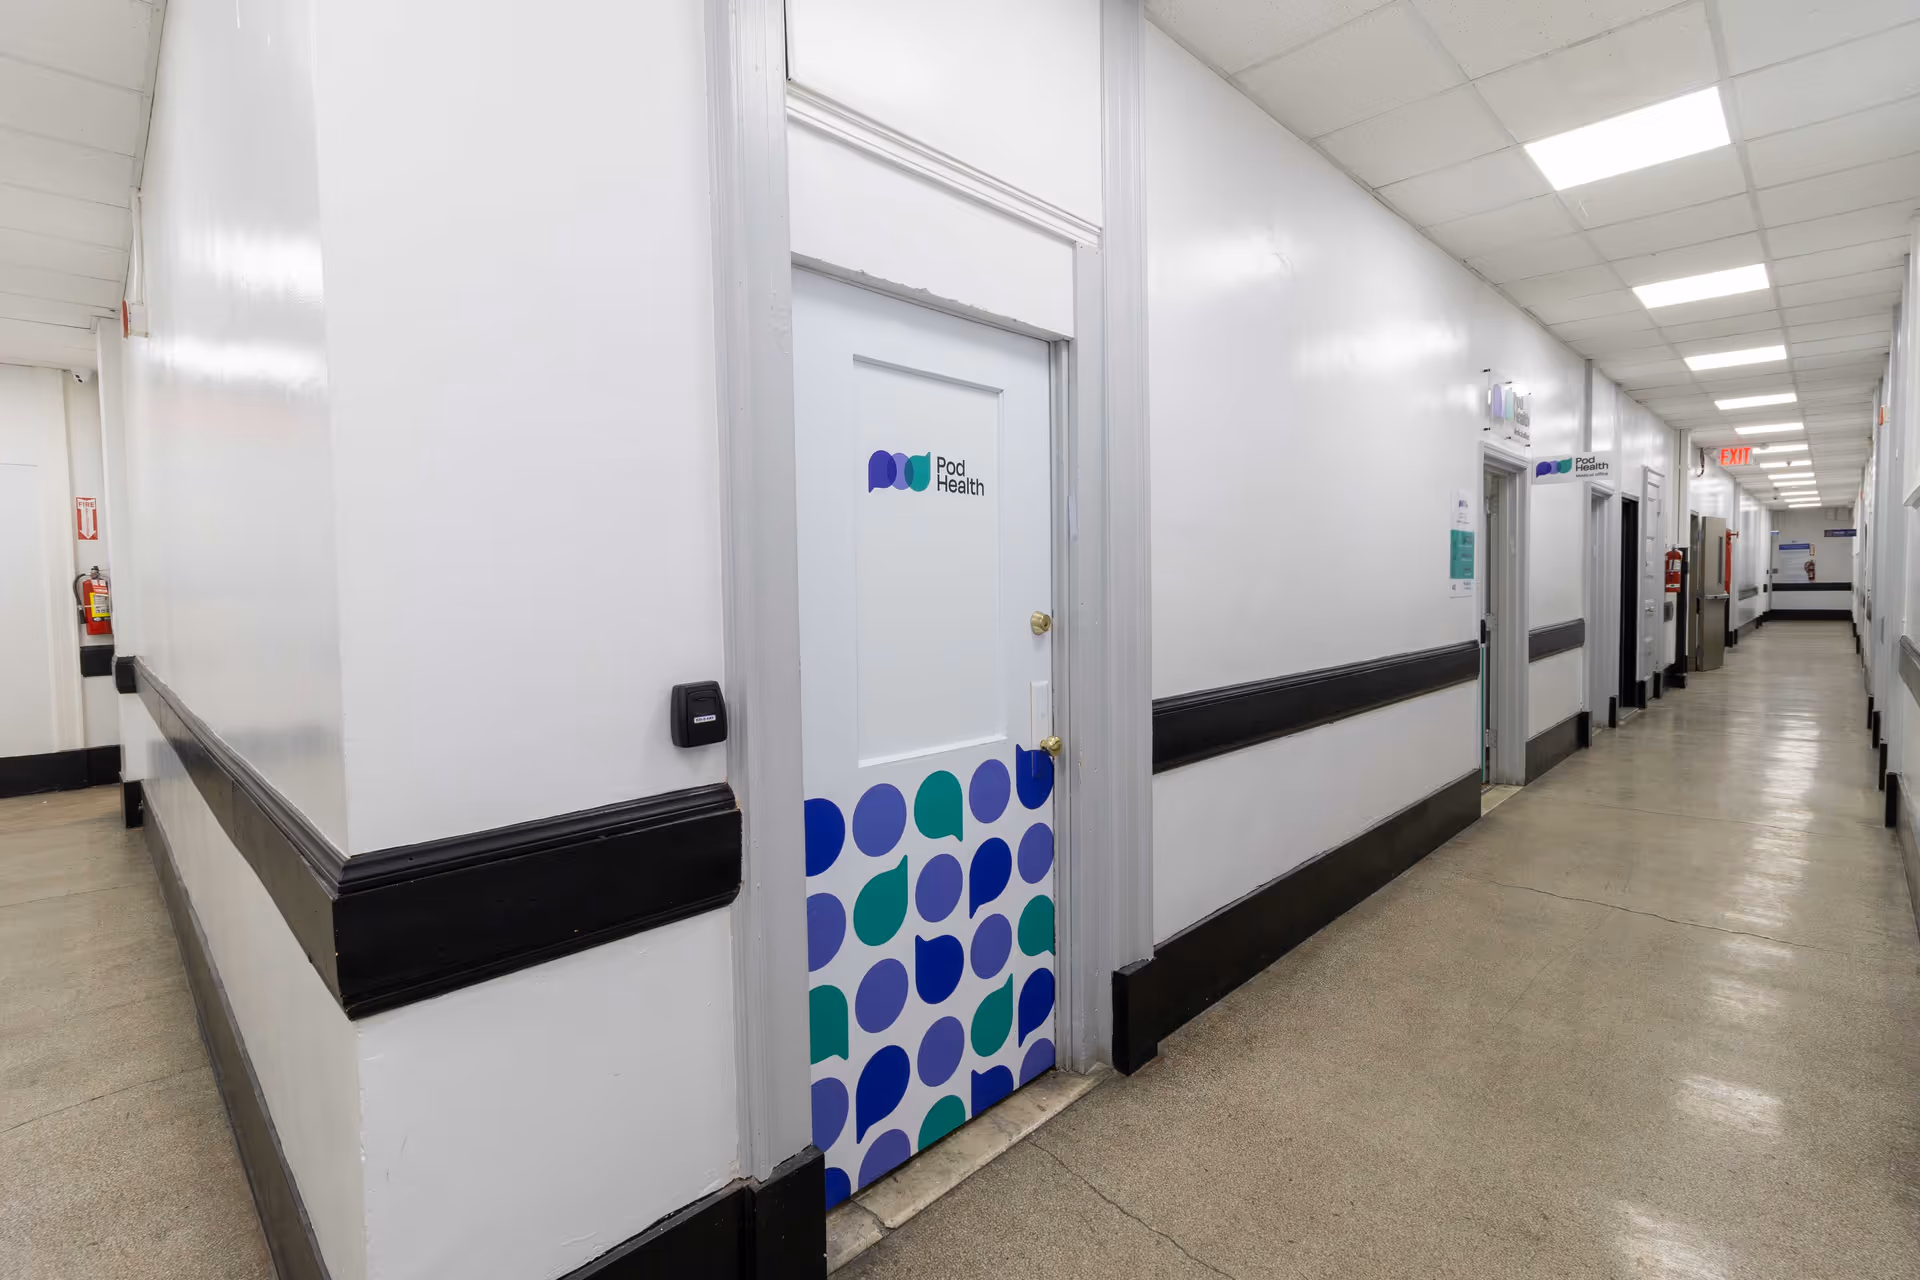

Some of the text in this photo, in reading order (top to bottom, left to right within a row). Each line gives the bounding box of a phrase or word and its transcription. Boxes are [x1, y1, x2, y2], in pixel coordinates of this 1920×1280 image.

[1575, 456, 1596, 465] Pod
[1720, 447, 1751, 466] EXIT
[937, 456, 965, 477] Pod
[1575, 462, 1609, 472] Health
[937, 474, 985, 497] Health
